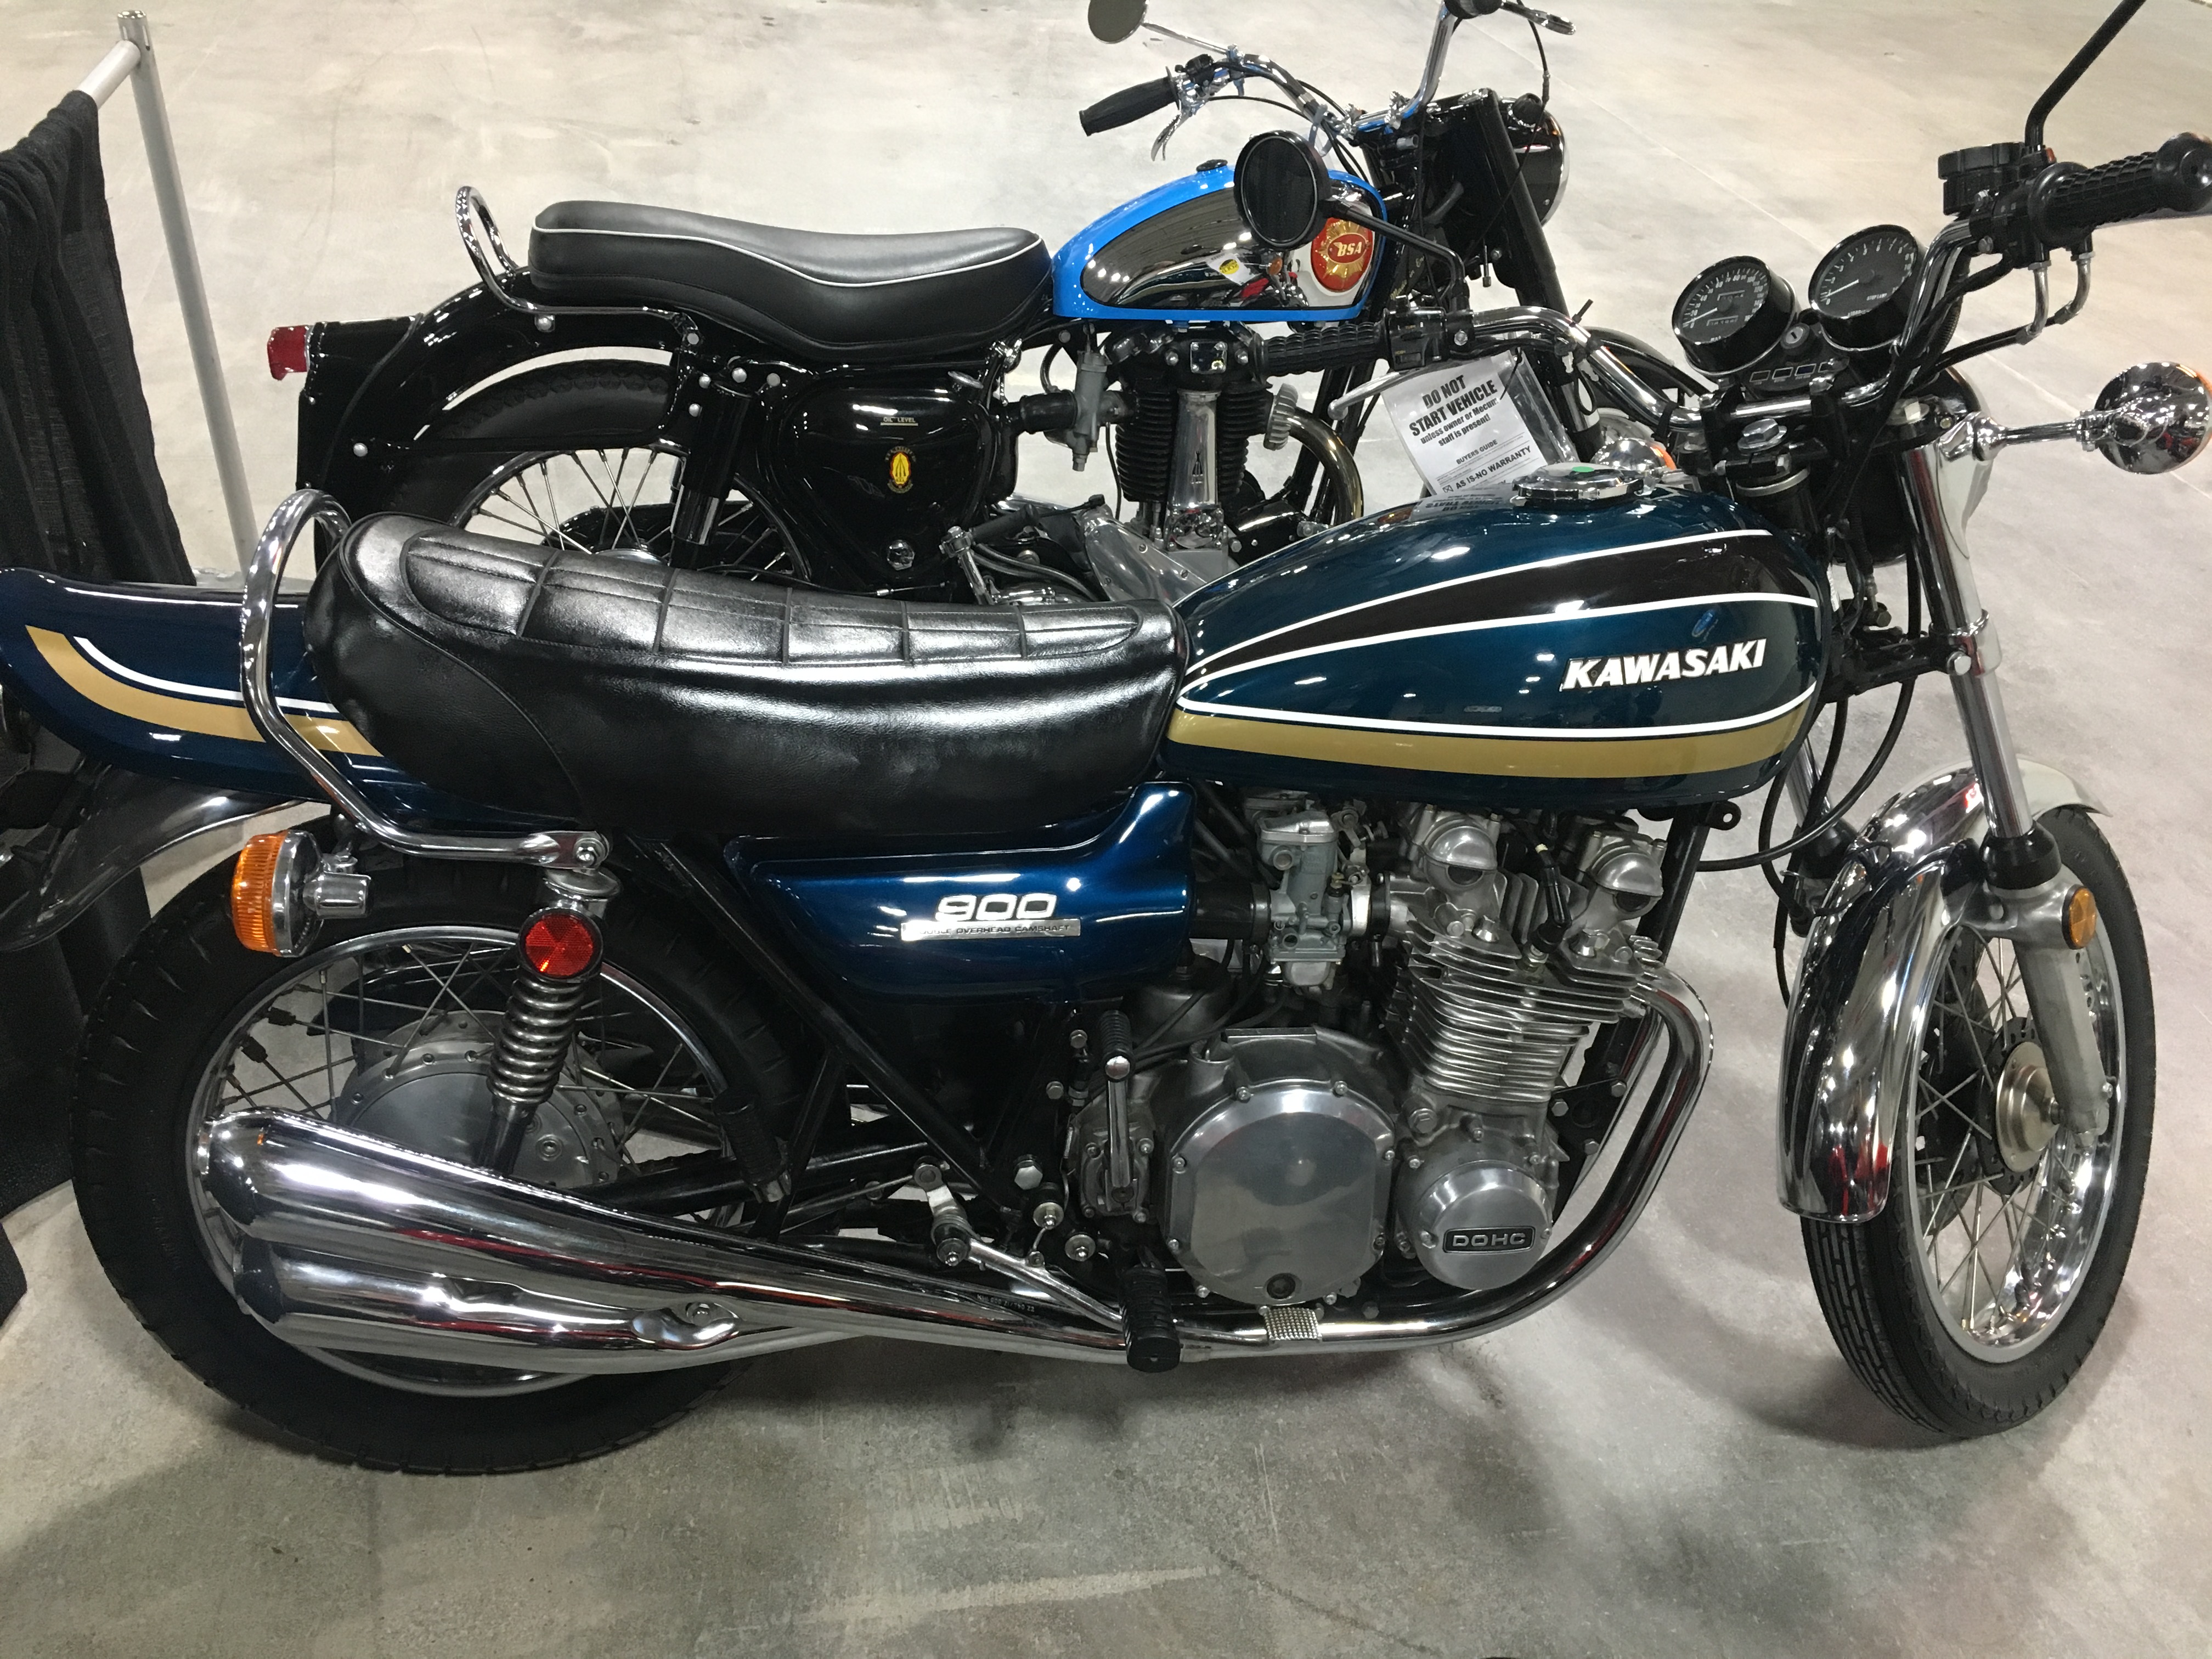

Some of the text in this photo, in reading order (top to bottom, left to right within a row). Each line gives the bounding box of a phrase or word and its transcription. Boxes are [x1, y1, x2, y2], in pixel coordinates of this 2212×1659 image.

[1333, 242, 1362, 257] BSA
[1409, 380, 1498, 436] START VEHICLE
[1422, 375, 1466, 409] DO NOT
[1420, 428, 1443, 444] unless
[1443, 416, 1464, 432] owner
[1465, 411, 1472, 420] or
[1438, 413, 1491, 446] staff is present!
[1455, 480, 1466, 489] AS
[1466, 469, 1487, 483] IS-NO
[1487, 445, 1531, 472] WARRANTY
[1456, 439, 1498, 464] BUYERS GUIDE
[1561, 639, 1767, 690] KAWASAKI
[935, 893, 1057, 922] 900
[1015, 924, 1070, 933] CAMSHAFT
[1453, 1232, 1526, 1246] DOHC
